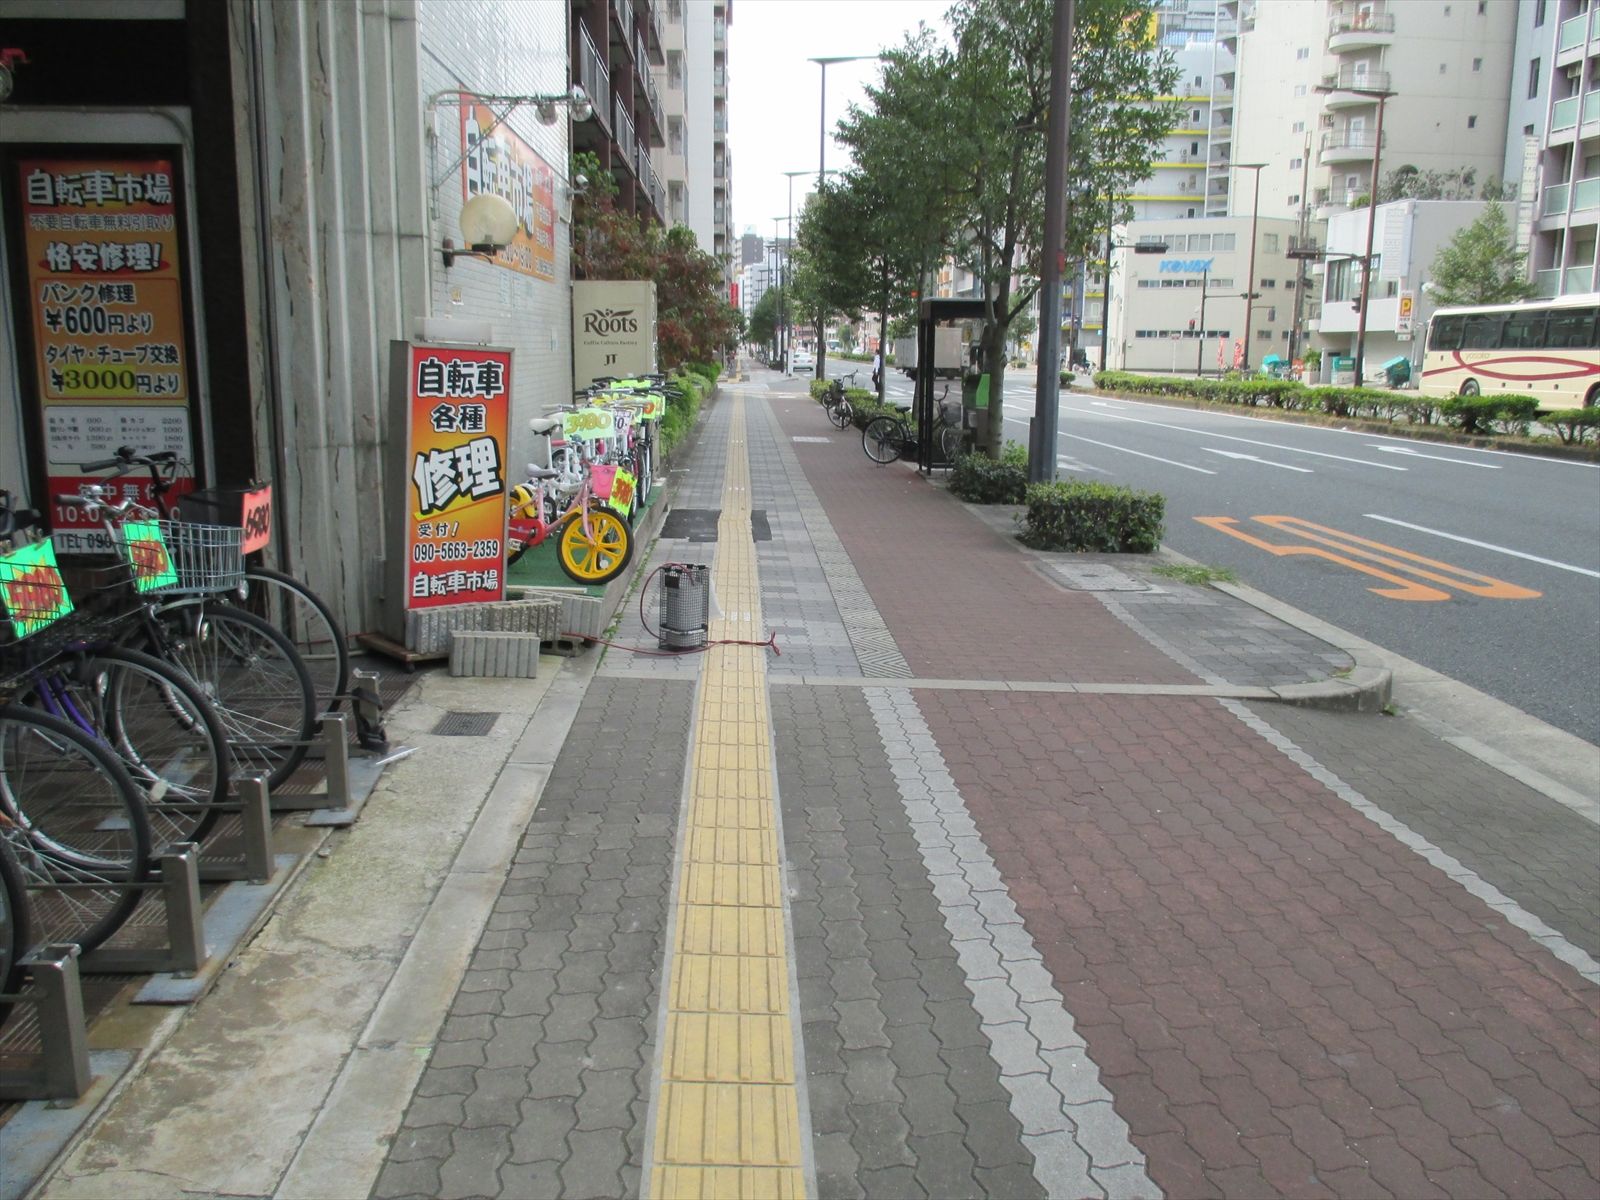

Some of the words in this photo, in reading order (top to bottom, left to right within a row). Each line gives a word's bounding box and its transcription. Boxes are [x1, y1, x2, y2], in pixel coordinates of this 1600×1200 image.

[27, 168, 172, 205] 自転車市場
[31, 214, 174, 231] 不要自転車無料引取り
[42, 283, 135, 303] パンク修理
[583, 310, 637, 336] Roots
[46, 345, 180, 363] タイヤ・チューブ交換
[604, 354, 619, 366] JT
[417, 357, 503, 398] 自転車
[431, 403, 486, 433] 各種
[412, 436, 503, 513] 修理
[413, 540, 499, 562] 090-5663-2359
[412, 570, 498, 598] 自転車市場
